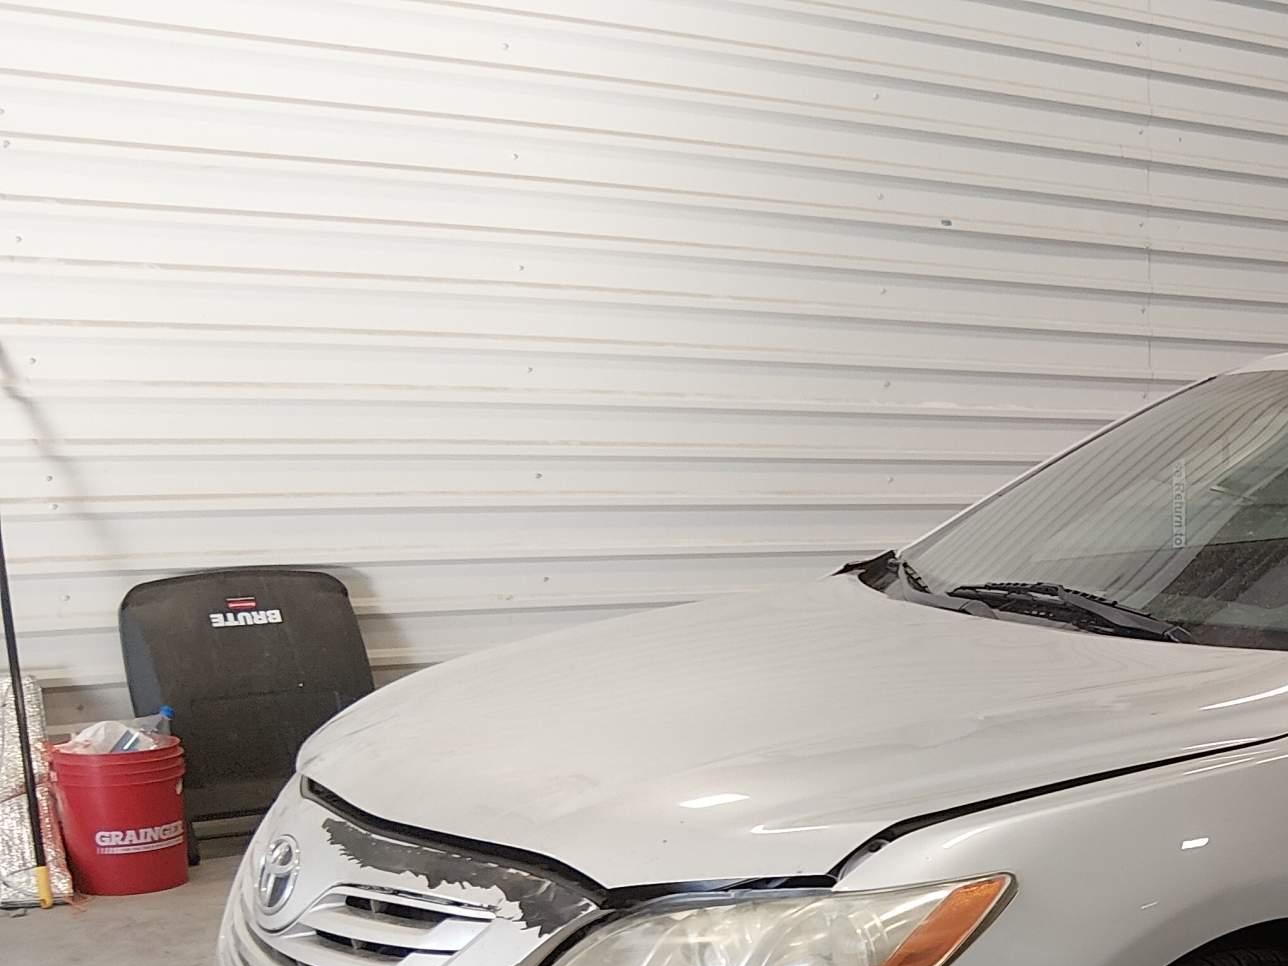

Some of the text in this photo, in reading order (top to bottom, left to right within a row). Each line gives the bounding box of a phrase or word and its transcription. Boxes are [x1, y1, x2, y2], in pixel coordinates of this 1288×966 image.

[1174, 482, 1185, 528] Return
[1174, 532, 1184, 546] to
[209, 609, 283, 628] BRUTE
